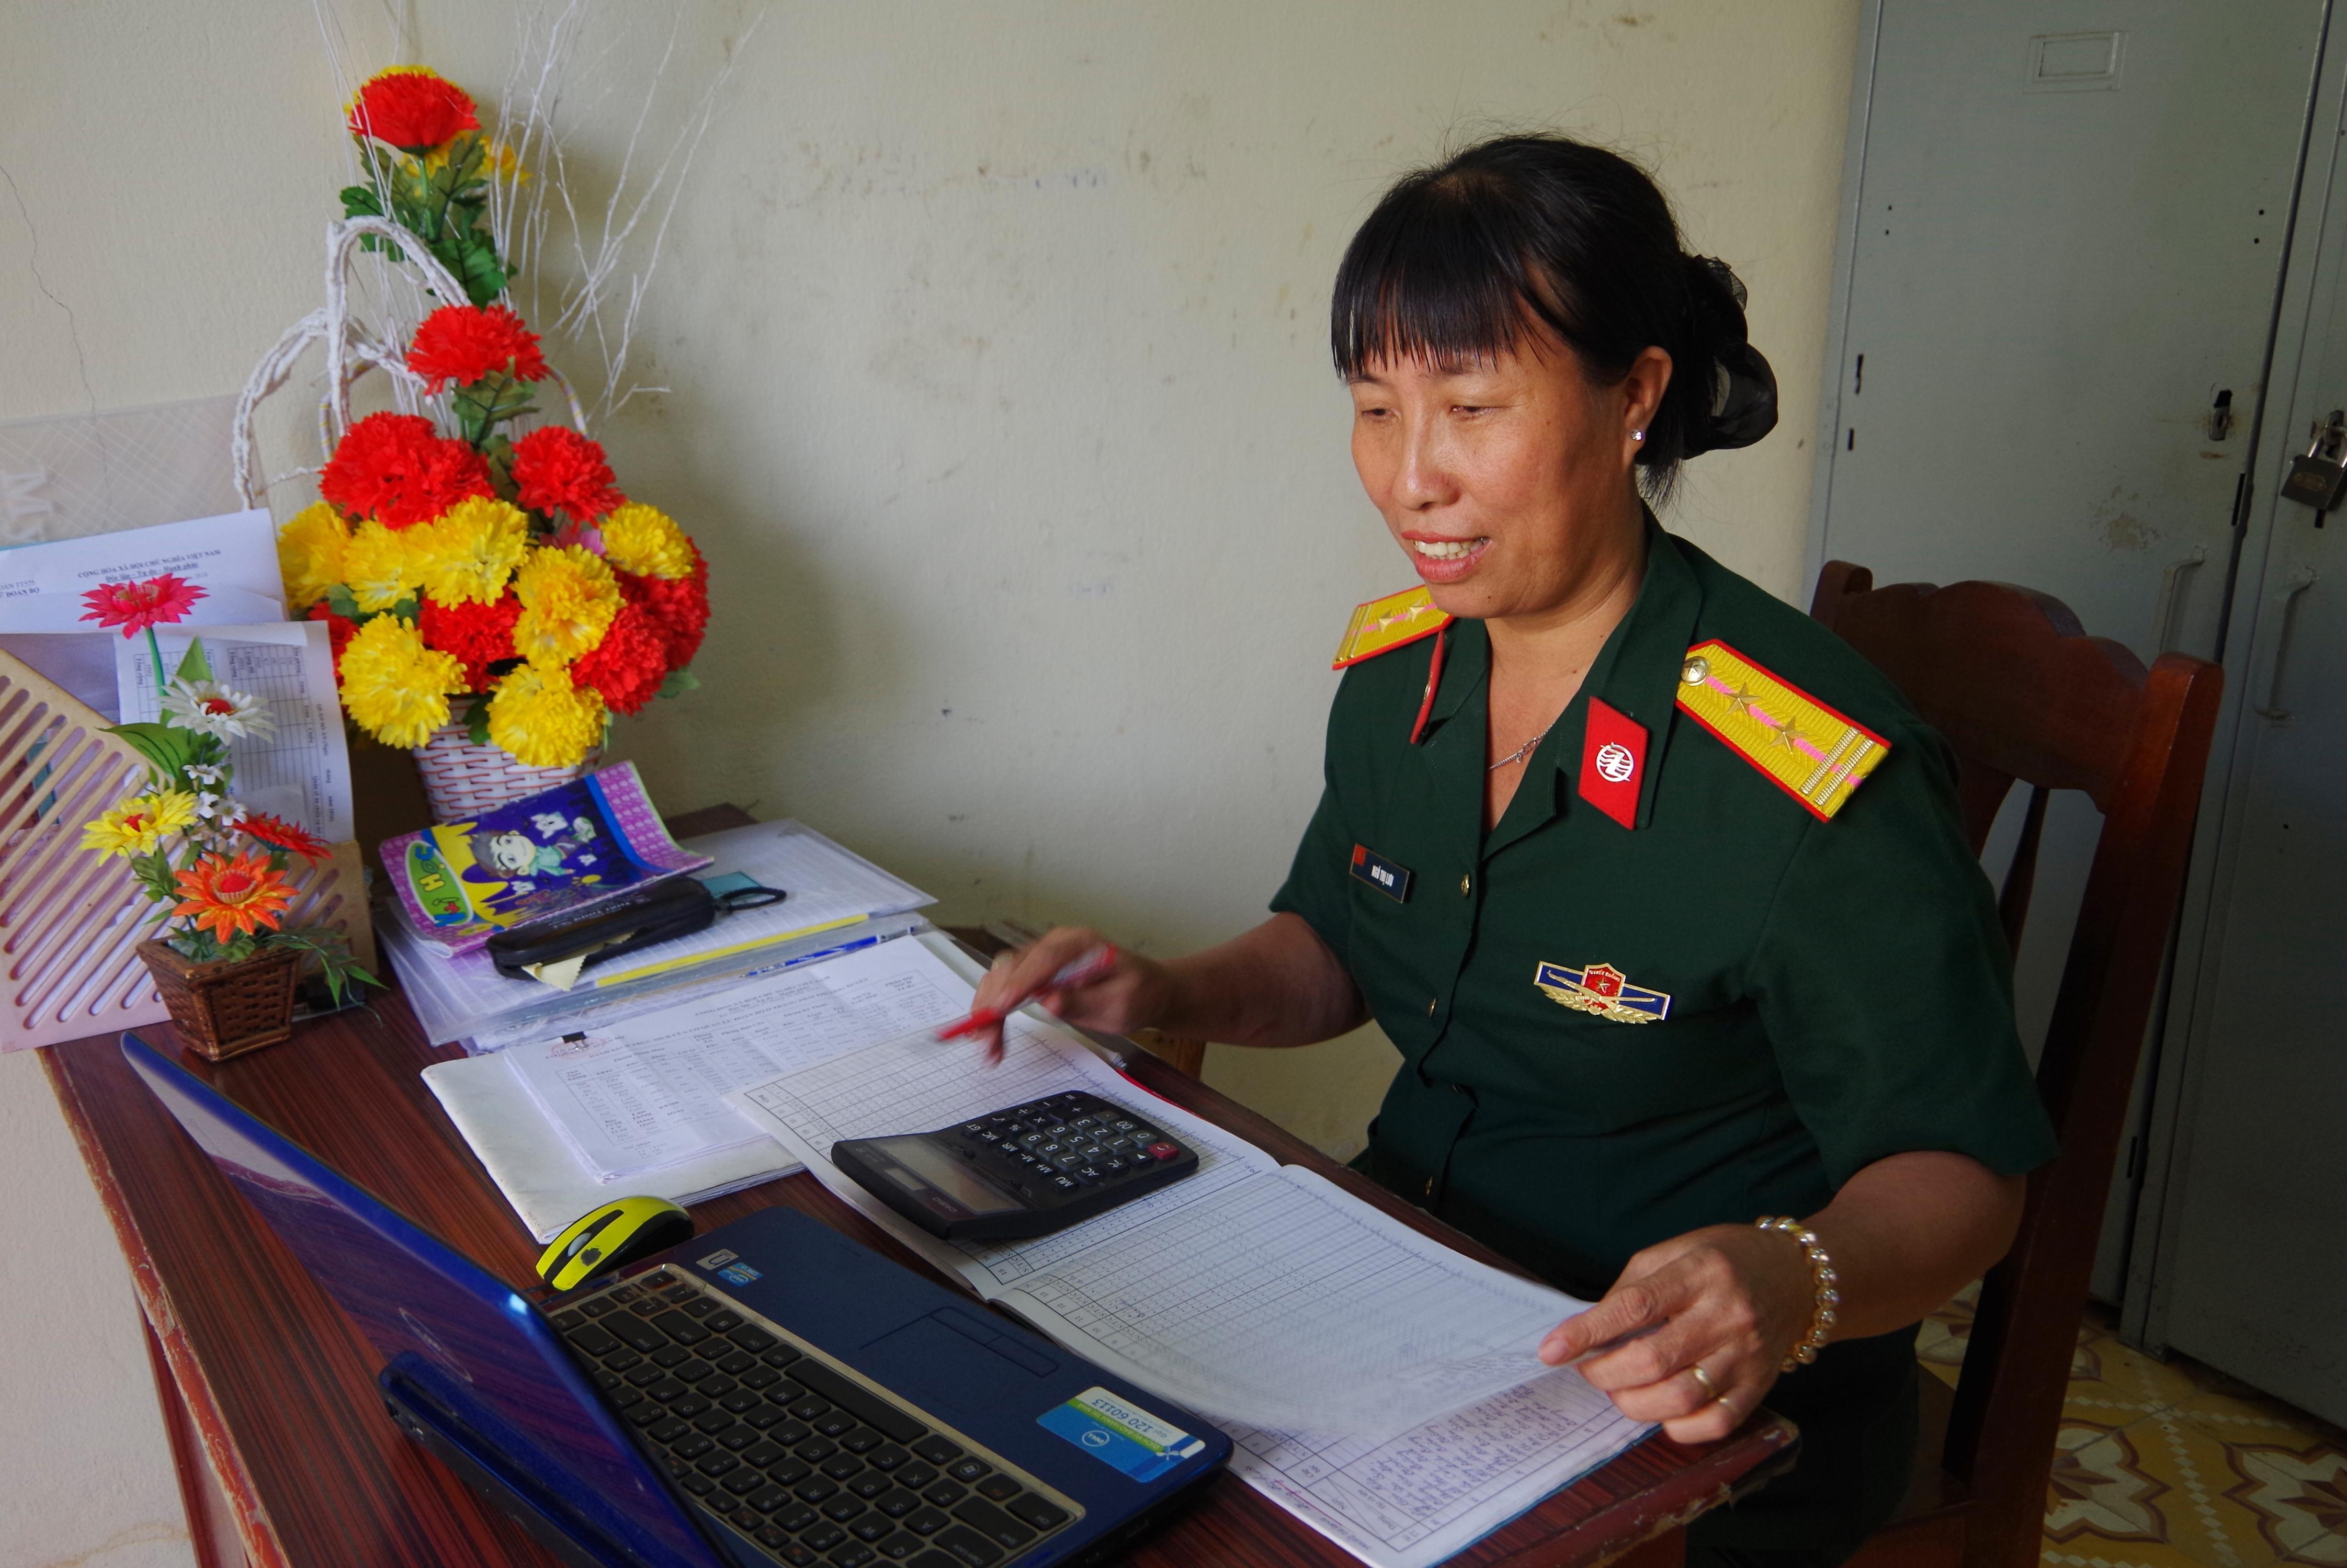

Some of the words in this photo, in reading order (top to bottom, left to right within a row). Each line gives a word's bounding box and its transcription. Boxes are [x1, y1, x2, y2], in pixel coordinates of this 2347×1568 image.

[1116, 1121, 1133, 1130] 00
[981, 1131, 1000, 1141] MC
[1002, 1142, 1018, 1152] MR
[1036, 1163, 1053, 1174] M+
[1081, 1167, 1100, 1177] AC
[1055, 1176, 1074, 1187] MU
[933, 1196, 957, 1213] CASIO
[777, 1392, 790, 1400] M
[803, 1407, 814, 1416] N
[1092, 1399, 1129, 1419] 60113
[1127, 1418, 1154, 1433] 120
[1087, 1433, 1105, 1445] DELL
[909, 1474, 923, 1484] X
[809, 1489, 821, 1498] R
[864, 1484, 876, 1493] D
[938, 1493, 951, 1502] Z
[892, 1503, 904, 1511] S
[837, 1508, 849, 1517] E
[1035, 1515, 1050, 1525] Ctrl
[862, 1526, 876, 1535] W
[999, 1533, 1018, 1546] Shift
[858, 1550, 870, 1559] 2
[893, 1546, 906, 1556] Q
[953, 1543, 969, 1556] Lock
[967, 1552, 983, 1566] Caps
